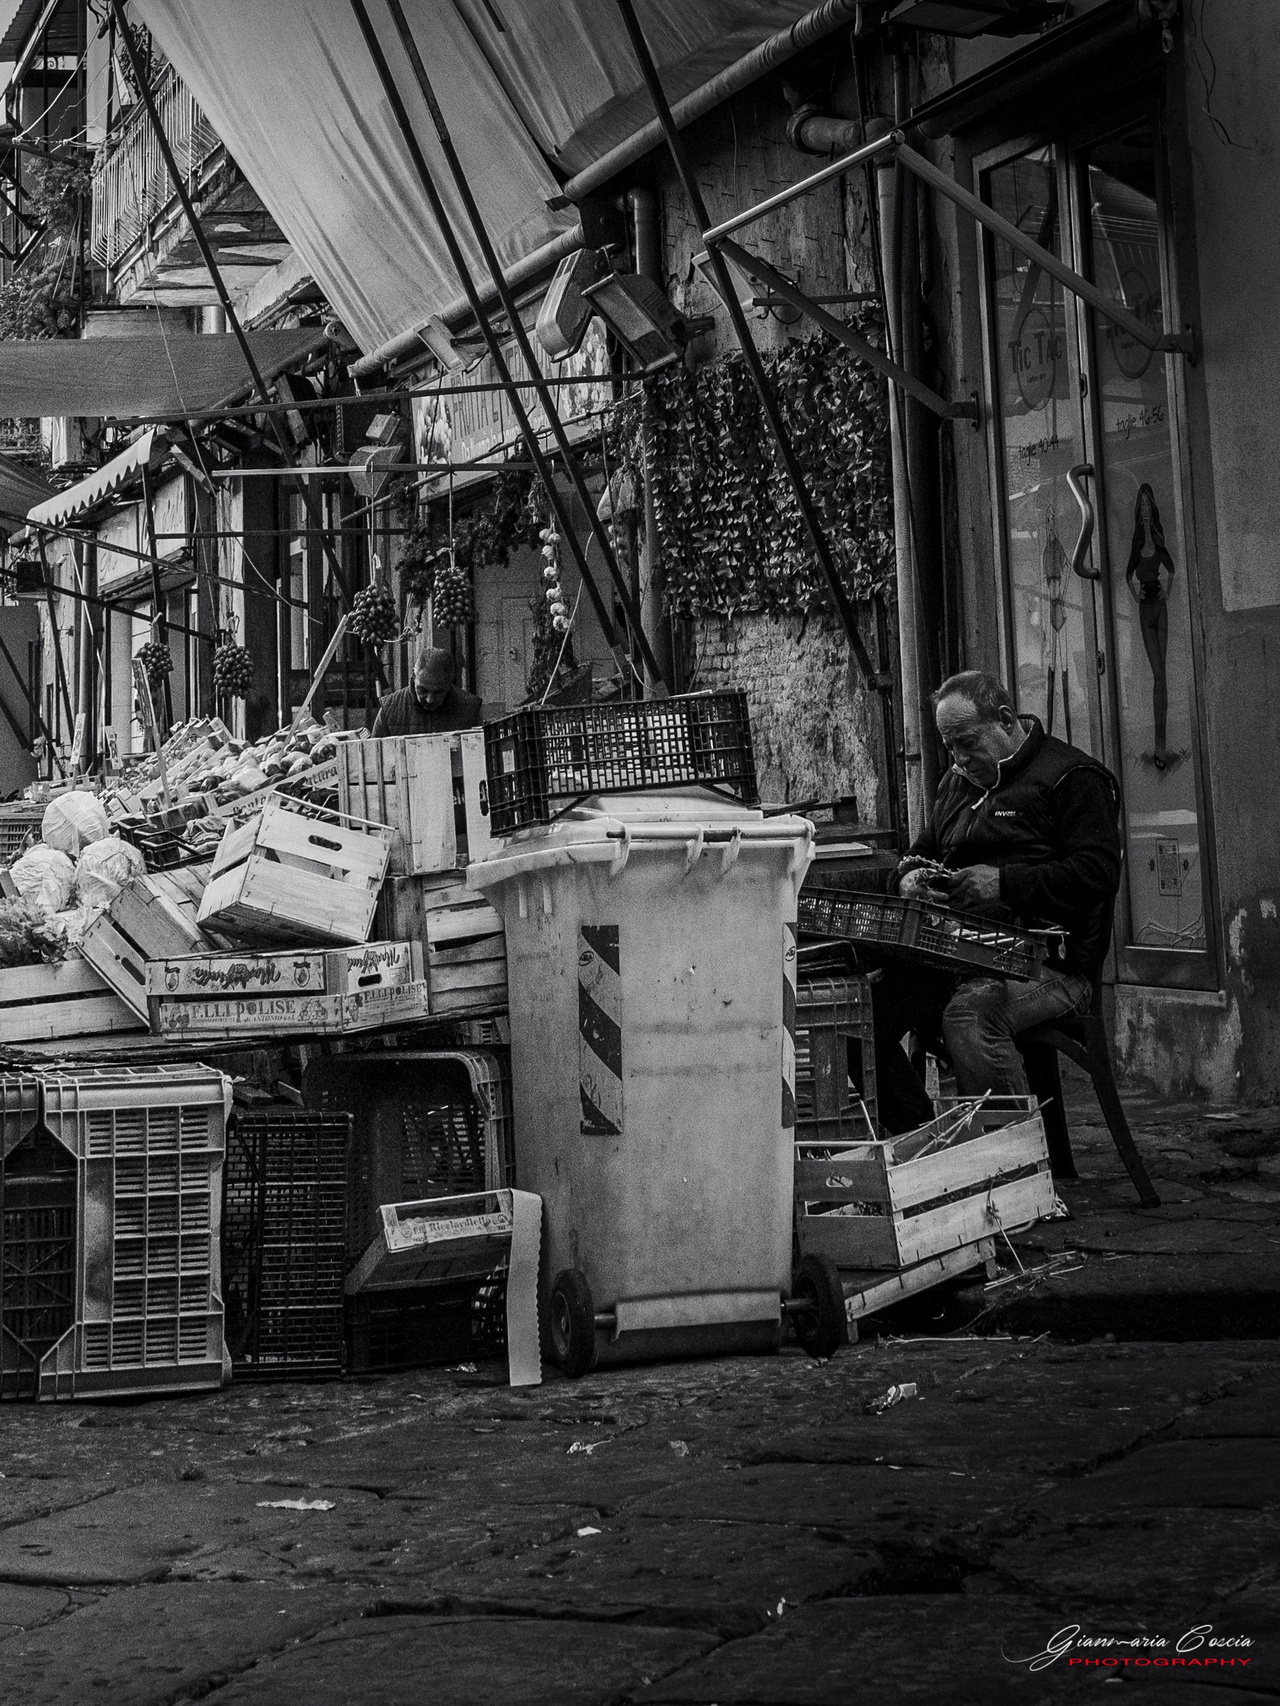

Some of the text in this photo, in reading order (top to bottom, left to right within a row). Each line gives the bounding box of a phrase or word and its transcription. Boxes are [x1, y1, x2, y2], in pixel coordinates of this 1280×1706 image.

[1008, 330, 1063, 374] TIC TAC
[192, 998, 296, 1022] F.LLI POLISE
